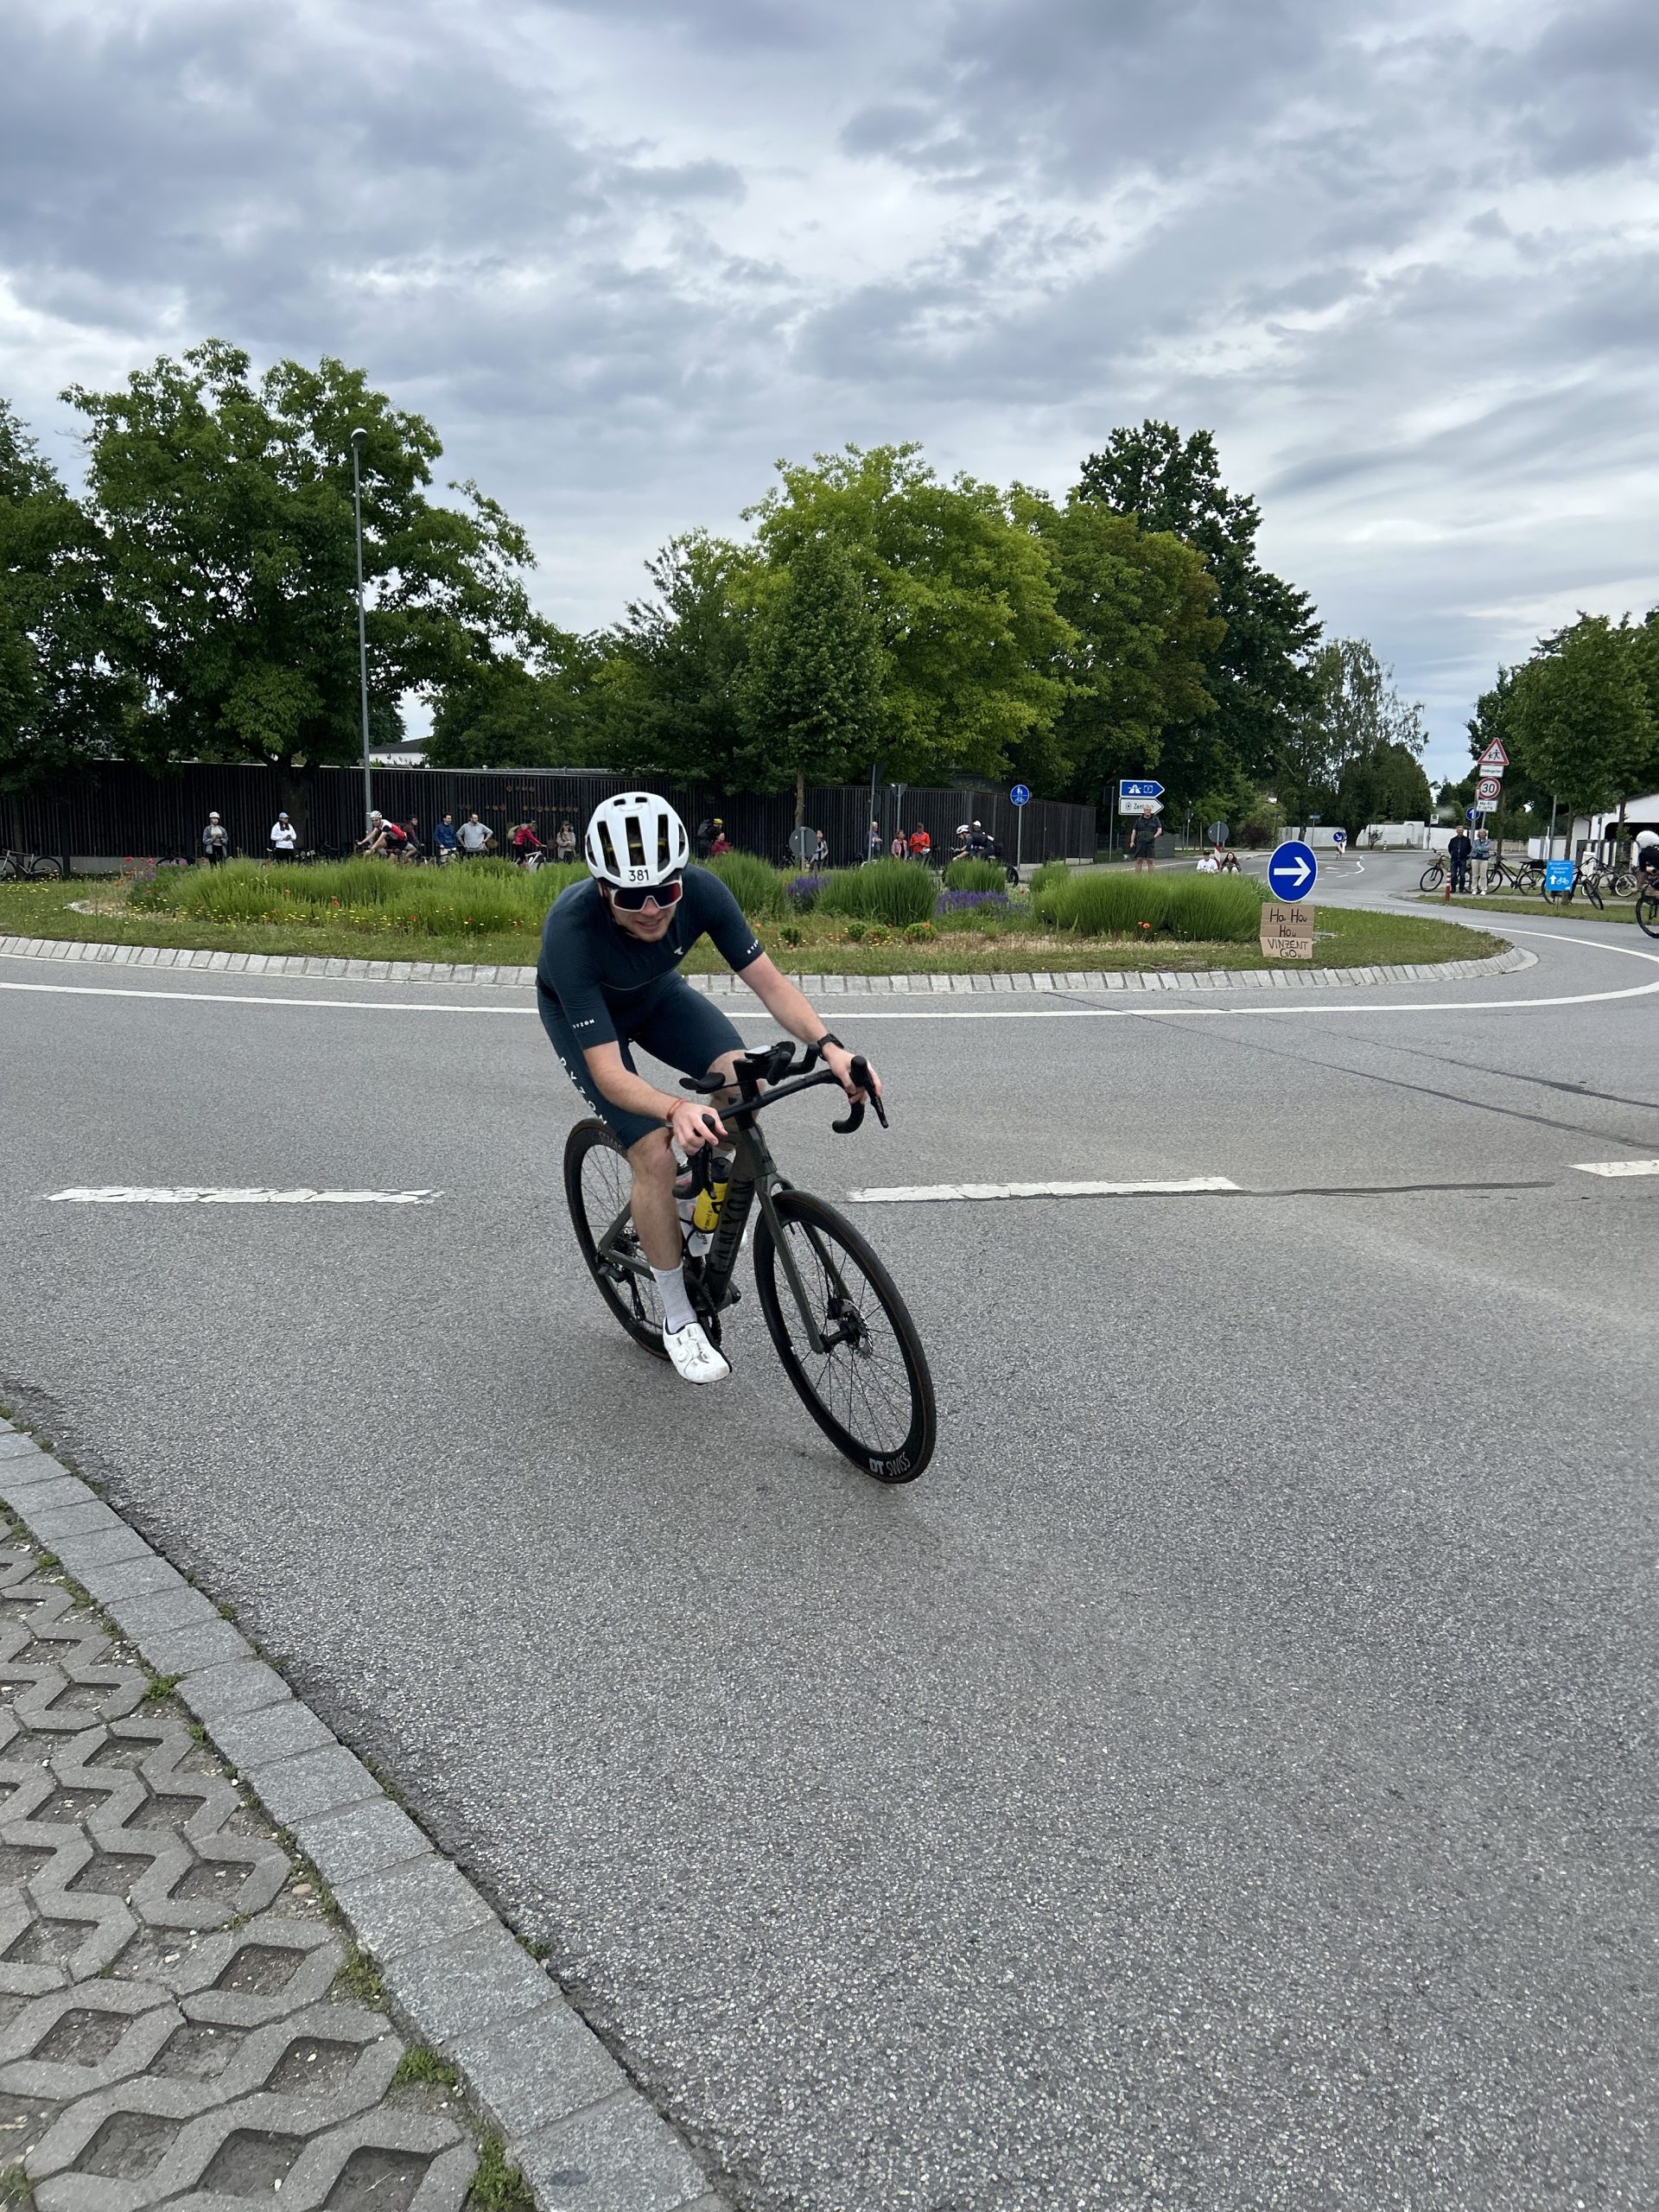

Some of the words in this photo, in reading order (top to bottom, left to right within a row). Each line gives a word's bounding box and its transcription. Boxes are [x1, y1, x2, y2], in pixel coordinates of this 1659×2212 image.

[1482, 783, 1496, 793] 30
[628, 869, 650, 882] 381
[1267, 938, 1309, 950] VINZENT
[868, 1457, 884, 1476] DT
[886, 1452, 911, 1477] SWISS
